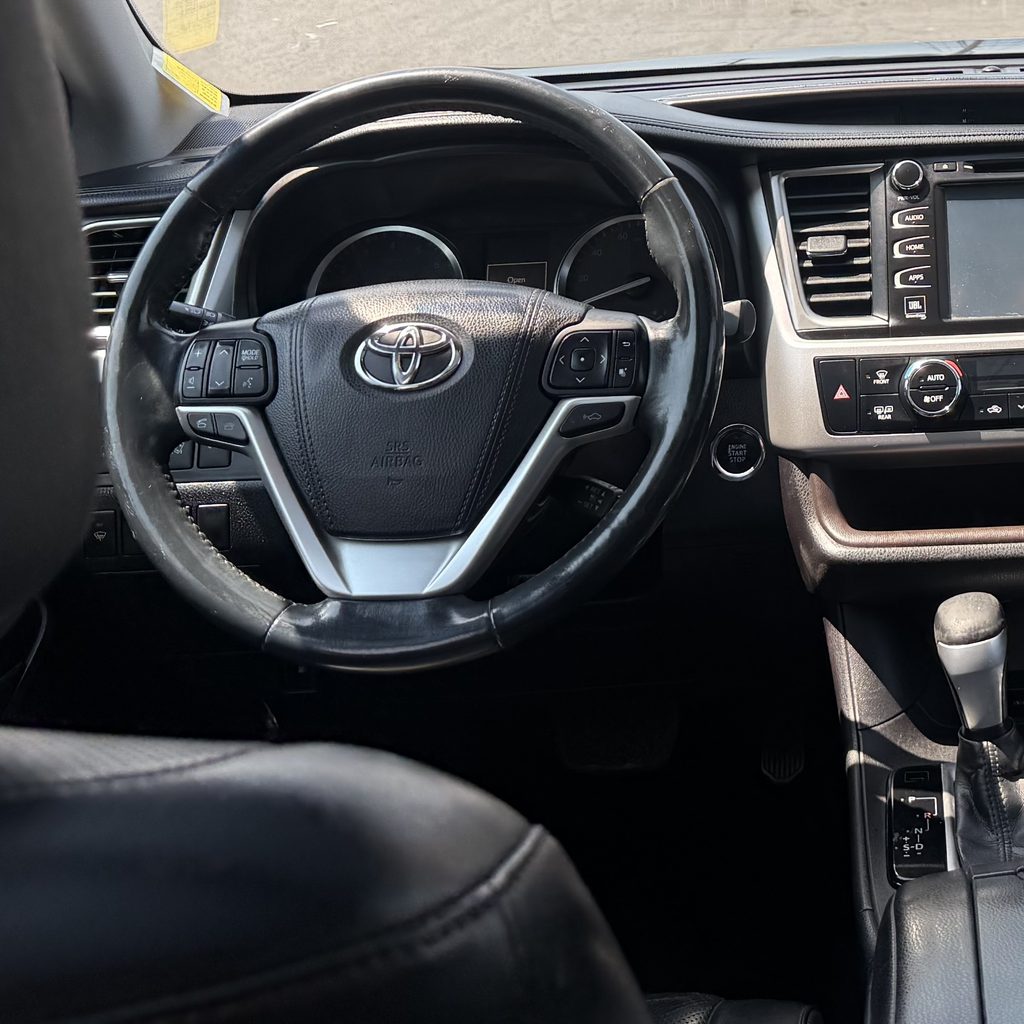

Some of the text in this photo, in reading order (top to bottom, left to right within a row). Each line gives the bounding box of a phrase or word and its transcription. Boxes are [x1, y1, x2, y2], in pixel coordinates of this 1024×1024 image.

[507, 276, 526, 284] Open
[908, 301, 922, 310] JBL
[930, 395, 944, 403] OFF
[384, 440, 411, 453] SRS
[370, 456, 423, 468] AIRBAG
[908, 796, 916, 804] P
[915, 843, 924, 851] D
